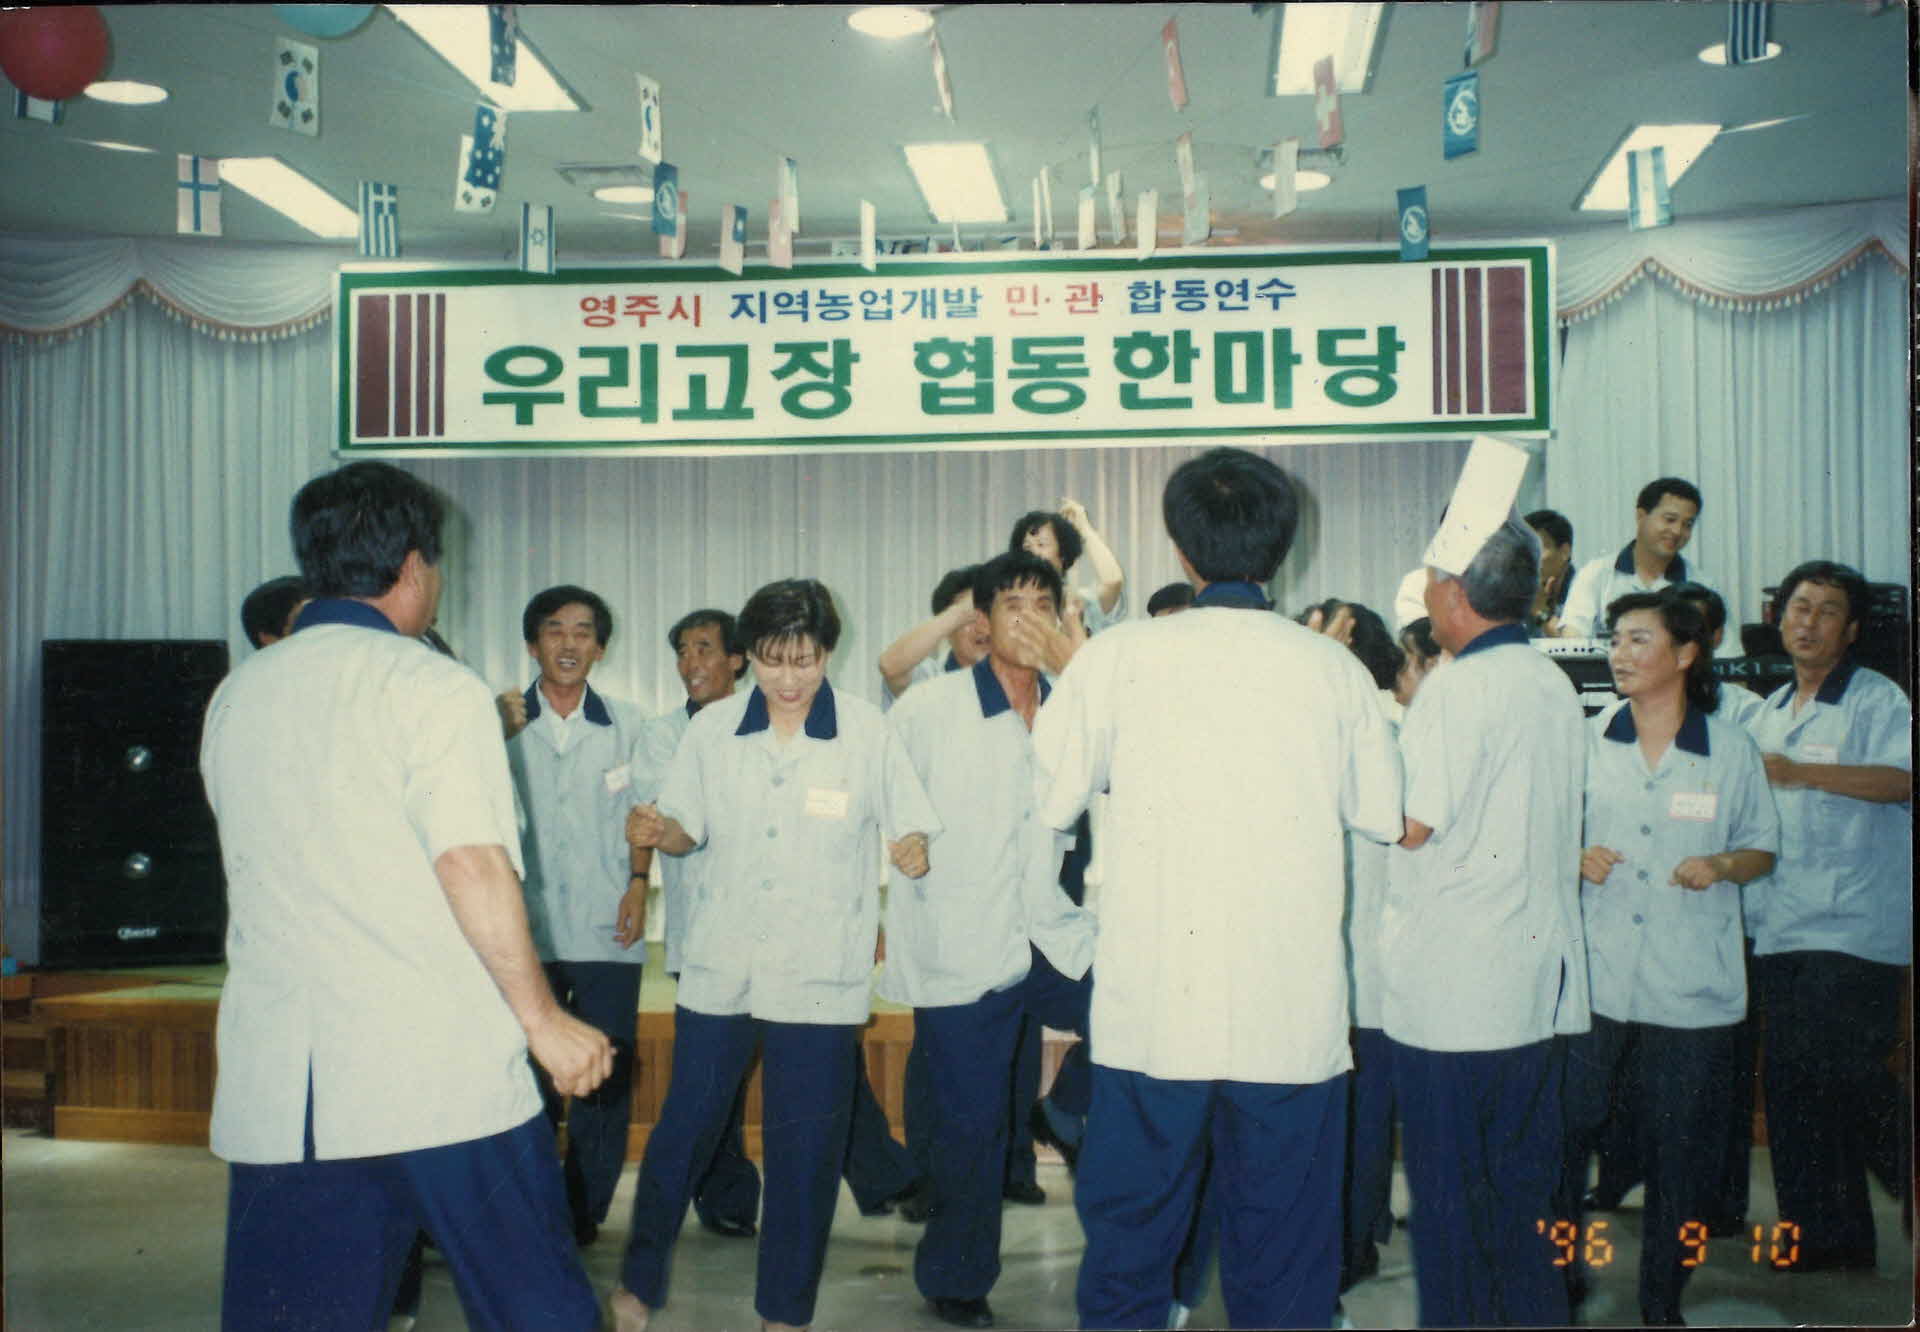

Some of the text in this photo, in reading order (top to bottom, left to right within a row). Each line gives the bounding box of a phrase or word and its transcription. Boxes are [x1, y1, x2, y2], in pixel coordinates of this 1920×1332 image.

[580, 294, 703, 329] 영주시
[730, 286, 983, 322] 지역농업개발
[1126, 276, 1298, 313] 합동연수
[482, 325, 1406, 426] 우리고장 협동한마당
